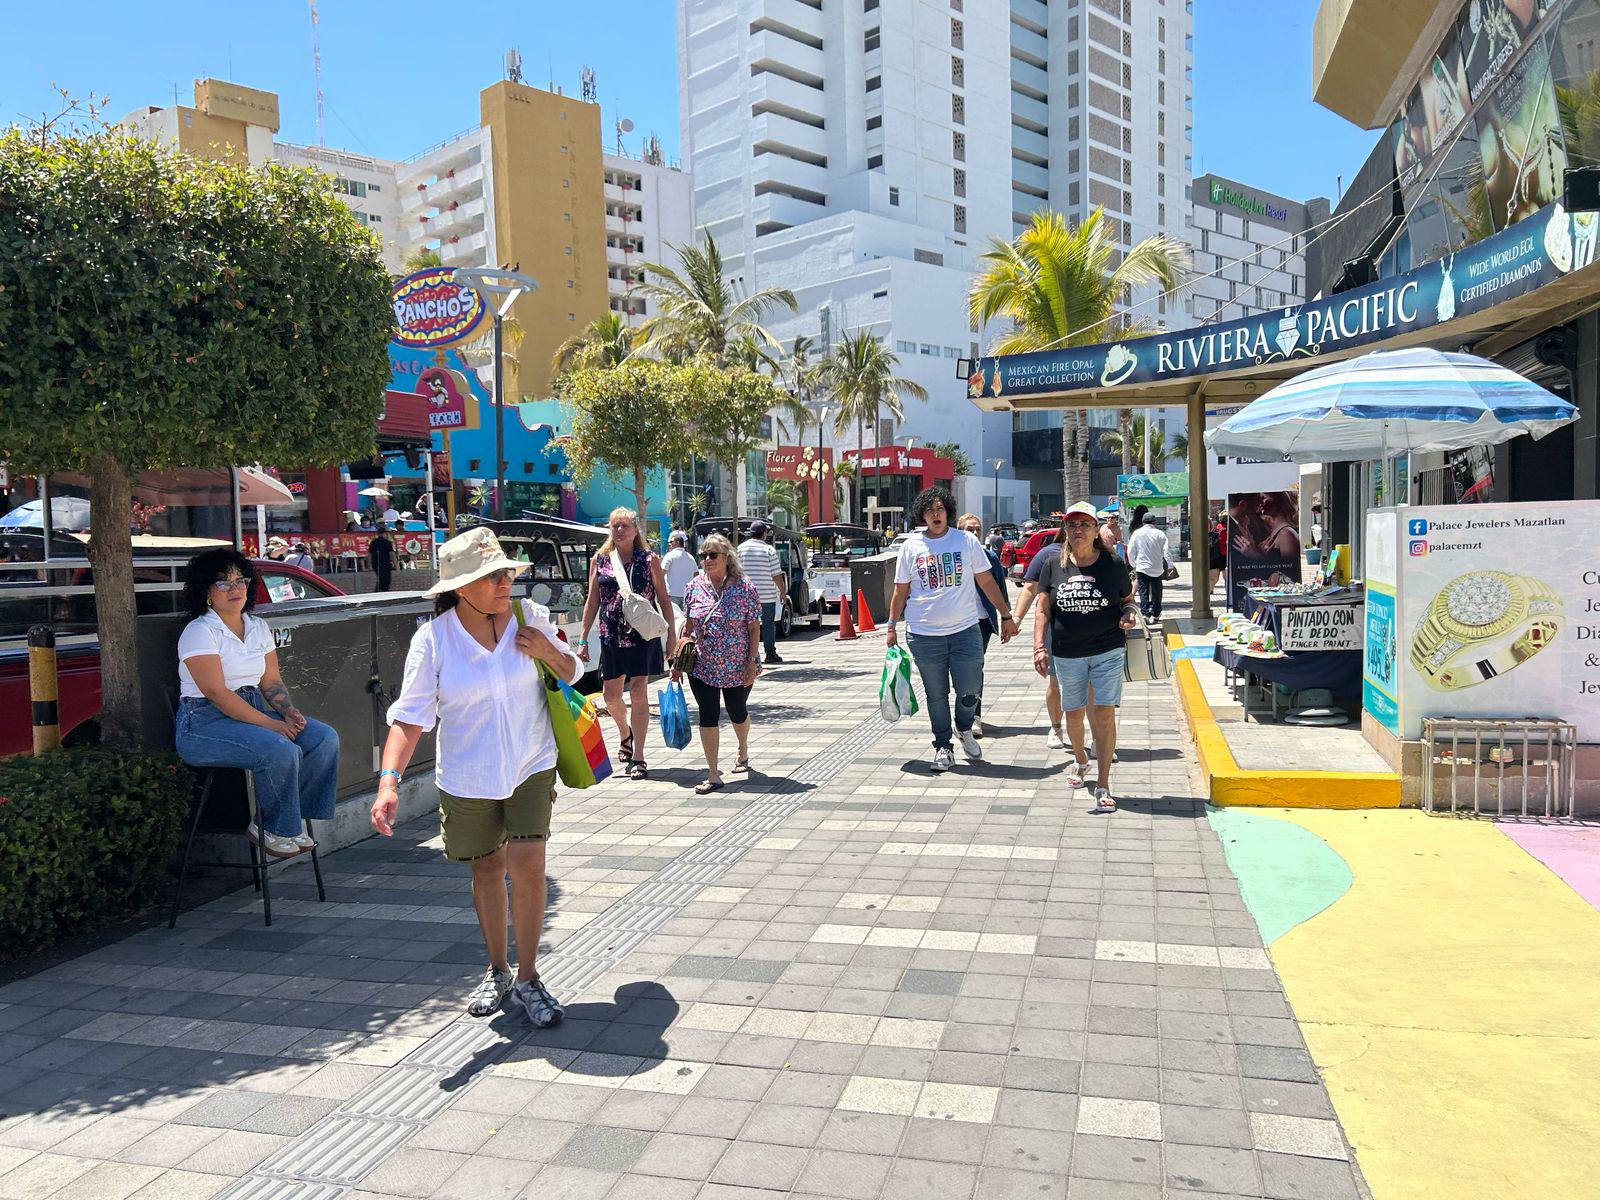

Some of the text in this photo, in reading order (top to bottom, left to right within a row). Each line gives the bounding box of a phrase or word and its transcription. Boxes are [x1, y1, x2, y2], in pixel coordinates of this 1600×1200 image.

[1468, 259, 1489, 278] WIDE
[1490, 244, 1519, 268] WORLD
[1460, 257, 1542, 303] CERTIFIED DIAMONDS
[393, 287, 475, 327] PANCHOS
[1157, 281, 1418, 373] RIVIERA PACIFIC
[1008, 359, 1094, 376] MEXICAN FIRE OPAL
[1008, 371, 1094, 388] GREAT COLLECTION
[766, 450, 796, 463] Flores
[1429, 517, 1566, 531] Palace Jewelers Mazatlan
[1429, 541, 1482, 553] palacemzt
[1056, 589, 1102, 599] Series &
[1056, 598, 1109, 607] Chisme &
[1287, 611, 1330, 628] PINTADO
[1332, 610, 1354, 625] CON
[1291, 628, 1338, 638] EL DEDO
[1323, 640, 1350, 648] PAINT
[1584, 653, 1600, 667] &
